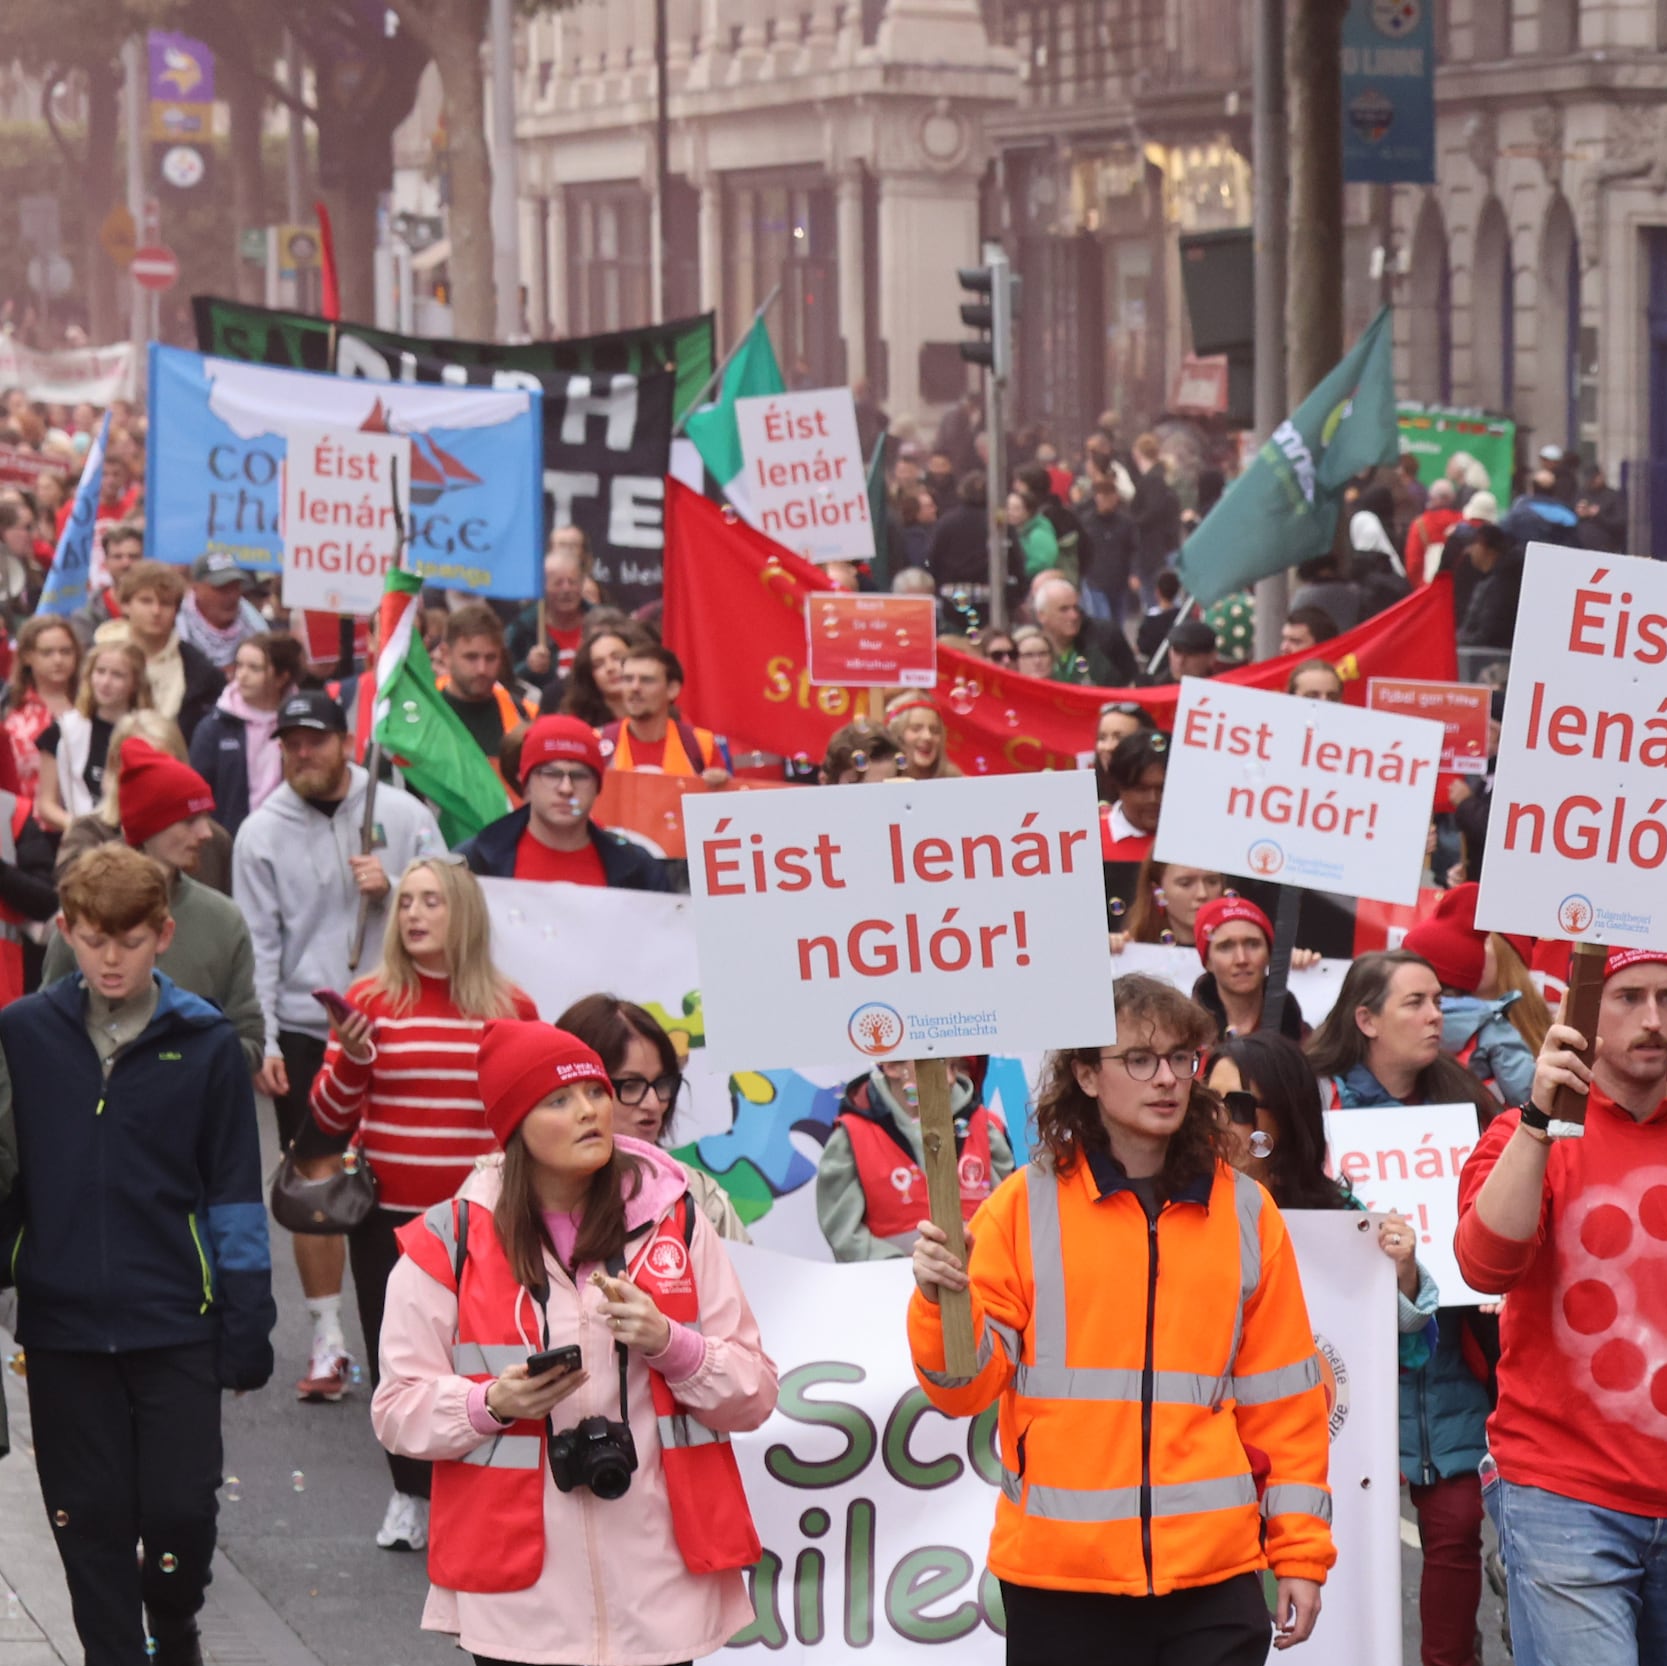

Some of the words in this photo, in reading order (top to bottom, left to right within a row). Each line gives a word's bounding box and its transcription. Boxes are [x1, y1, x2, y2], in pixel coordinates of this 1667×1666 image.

[765, 403, 830, 444] Éist
[314, 433, 380, 482] Éist
[756, 450, 846, 489] lenár
[299, 489, 393, 530] lenár
[757, 494, 868, 533] nGlór!
[293, 540, 392, 578] nGlór
[1182, 696, 1273, 762] Éist
[1301, 715, 1432, 788] lenár
[1225, 784, 1379, 842] nGlór!
[703, 817, 847, 897] Éist
[888, 812, 1089, 884] lenár
[797, 907, 1031, 981] nGlór!
[907, 1009, 998, 1028] Tuismitheoirí
[910, 1030, 926, 1041] na
[927, 1023, 998, 1039] Gaeltachta
